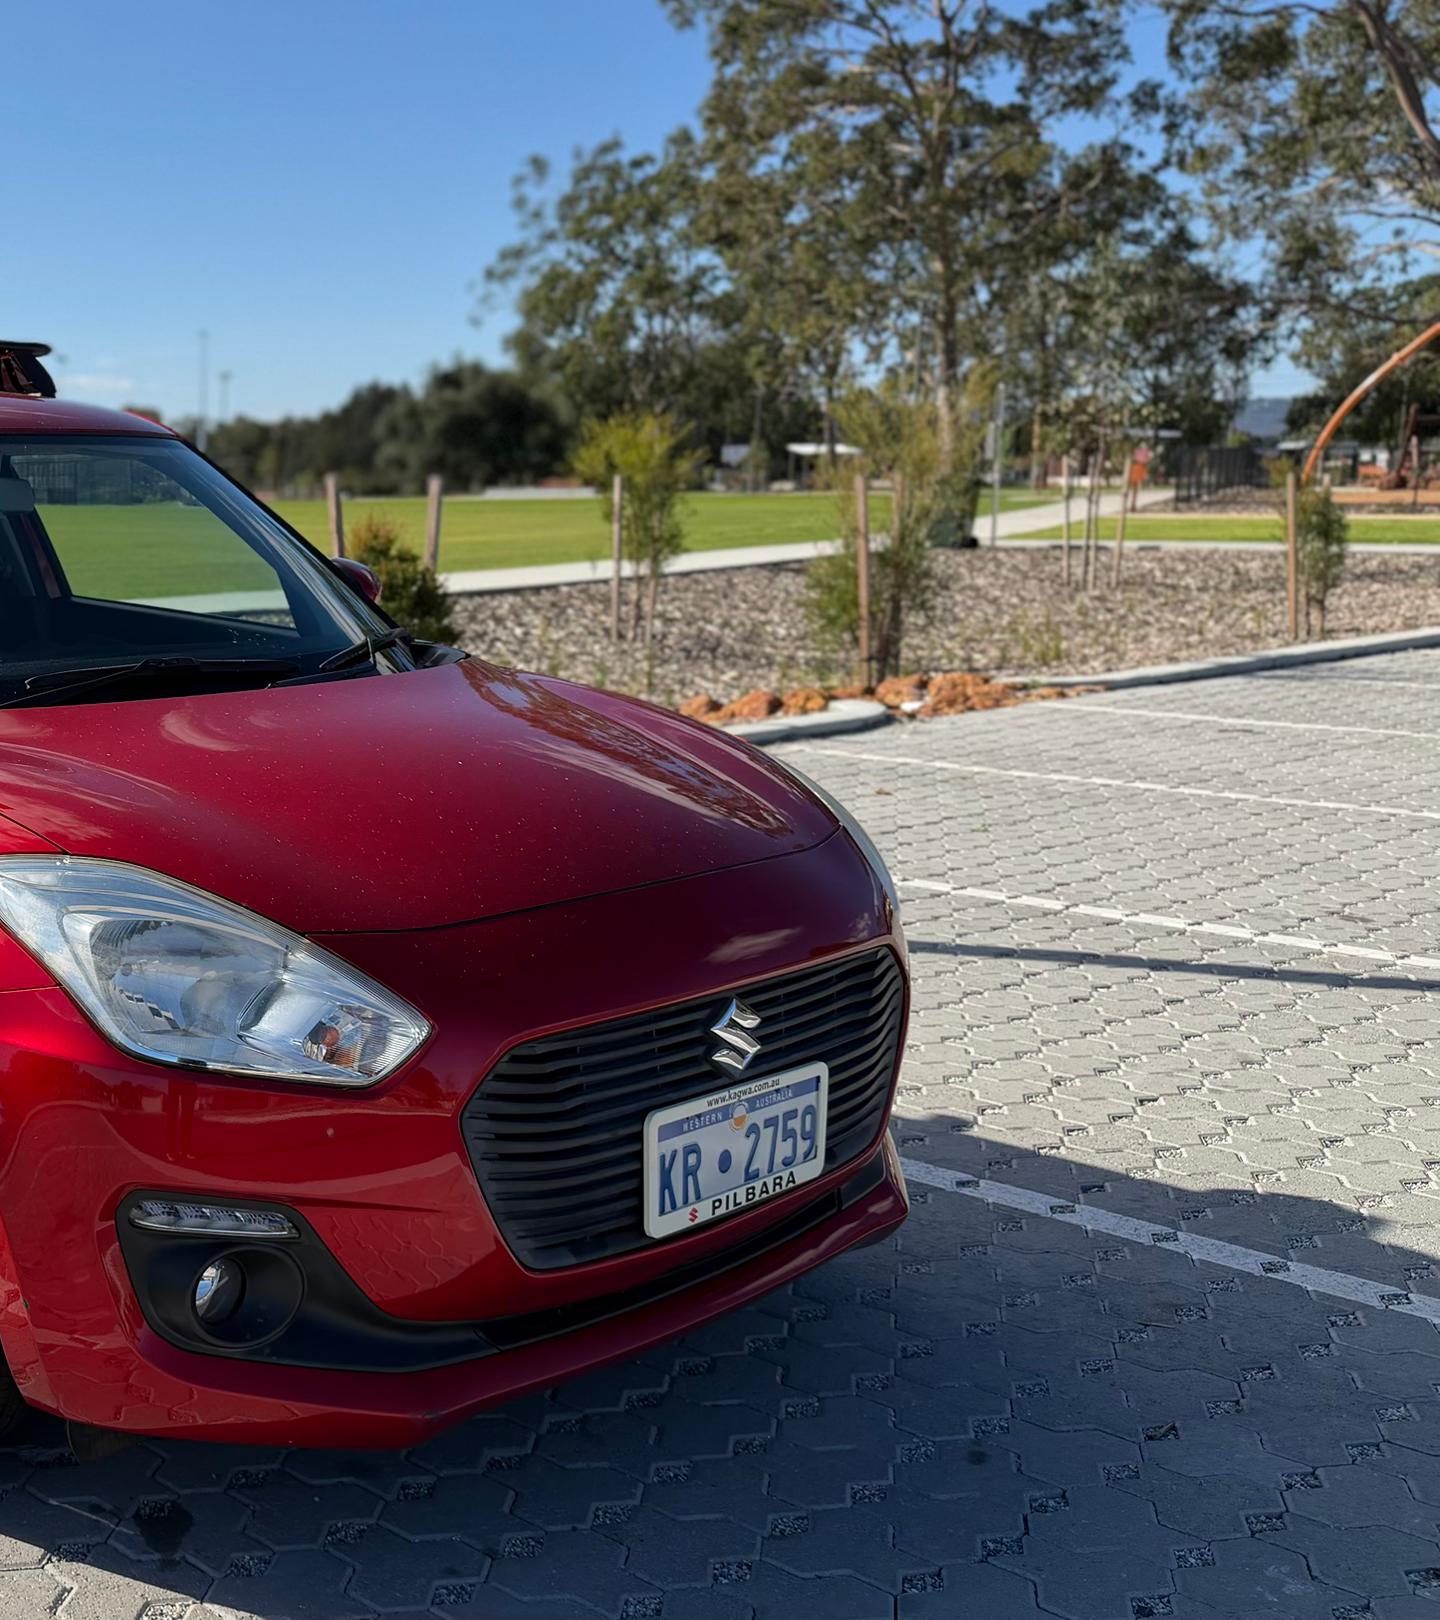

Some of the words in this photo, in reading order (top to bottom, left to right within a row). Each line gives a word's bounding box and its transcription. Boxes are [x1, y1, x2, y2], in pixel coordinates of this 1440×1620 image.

[682, 1111, 723, 1132] WESTERN
[754, 1089, 793, 1108] AUSTRALIA
[706, 1078, 780, 1107] www.kagwa.com.au
[658, 1143, 702, 1217] KR
[744, 1104, 817, 1182] 2759
[711, 1170, 797, 1216] PILBARA
